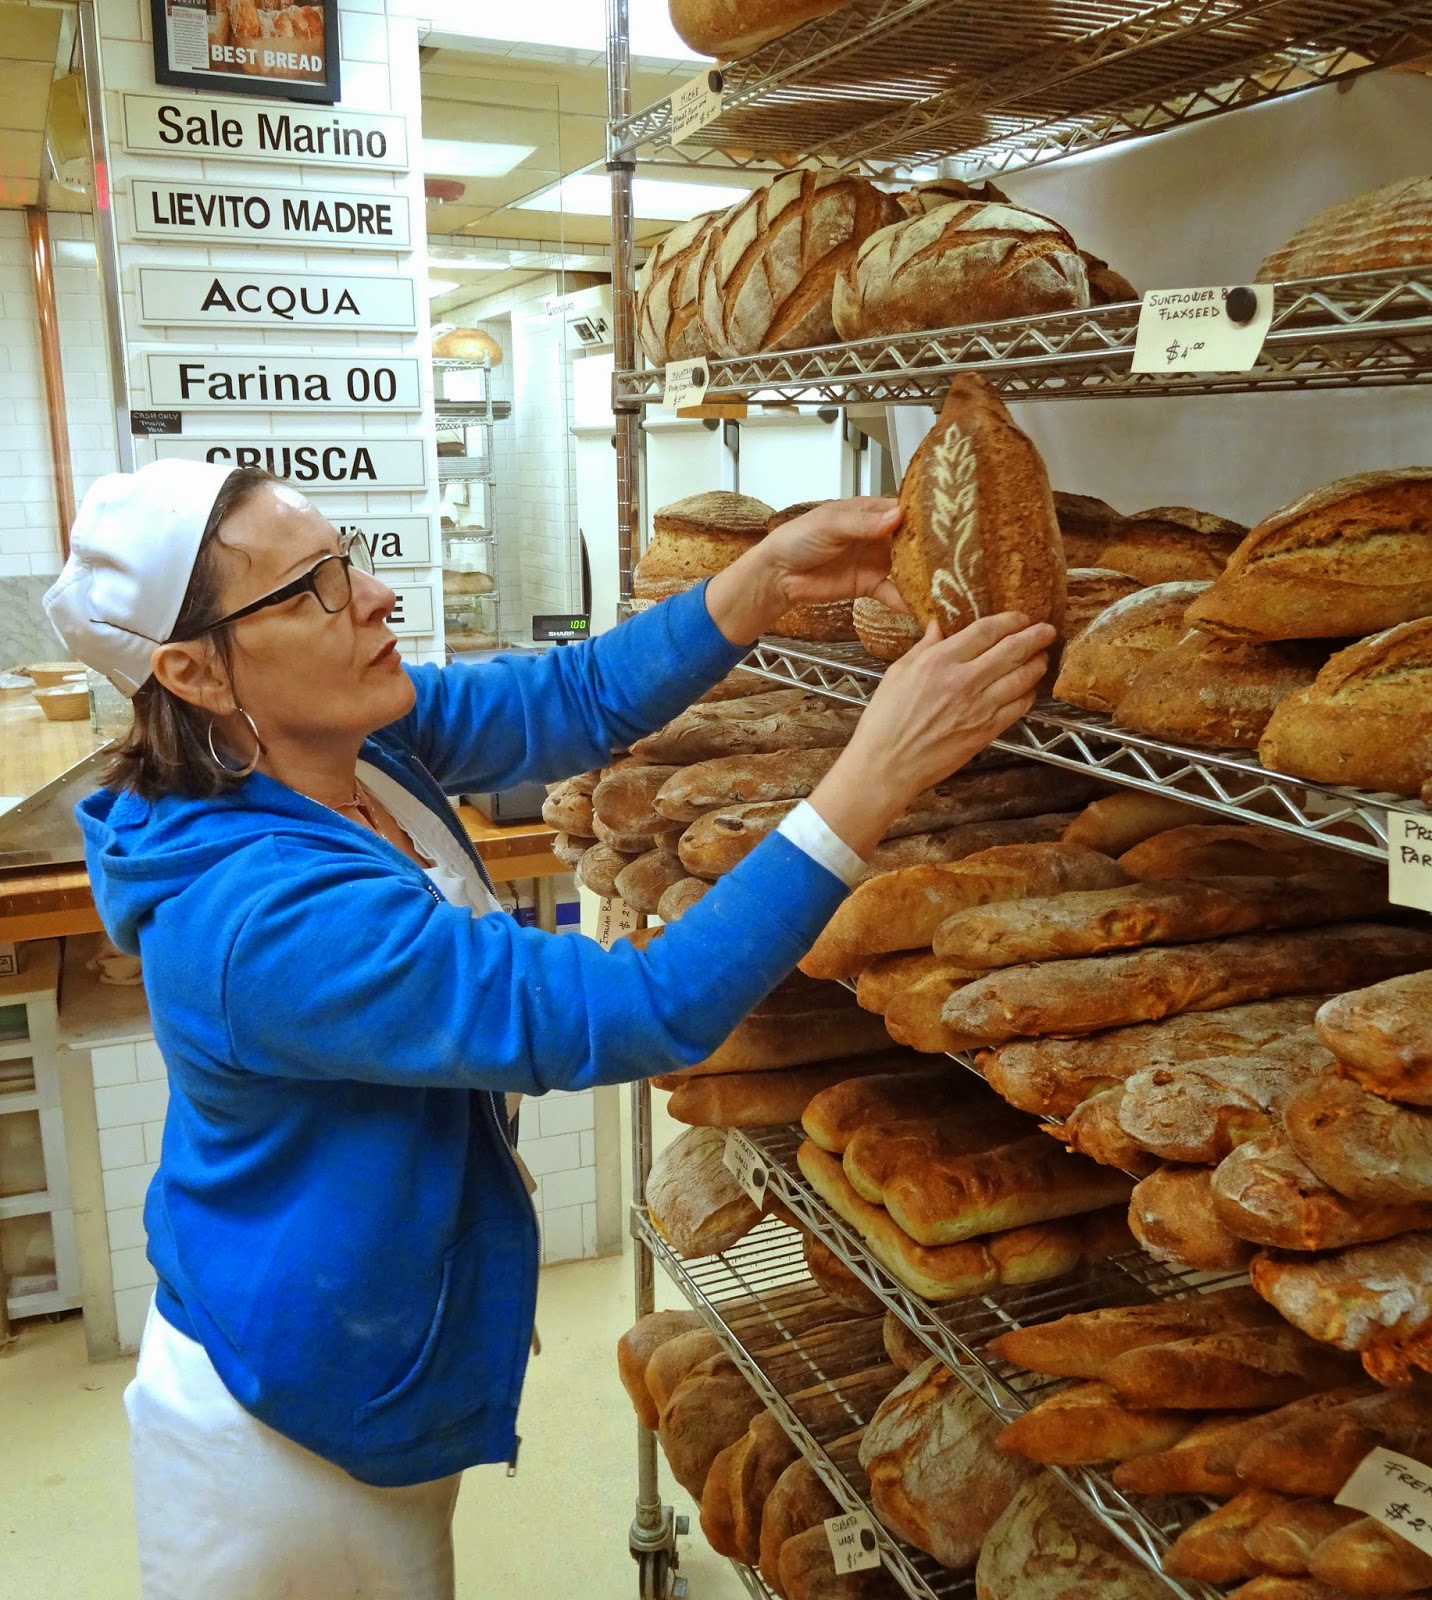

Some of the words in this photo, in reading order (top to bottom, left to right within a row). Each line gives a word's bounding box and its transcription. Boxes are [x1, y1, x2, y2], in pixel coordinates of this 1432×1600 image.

[211, 44, 257, 65] BEST
[264, 50, 323, 72] BREAD
[157, 105, 243, 148] Sale
[257, 112, 387, 159] Marino
[151, 191, 271, 230] LIEVITO
[282, 198, 393, 236] MADRE
[200, 278, 361, 320] ACQUA
[1149, 290, 1215, 307] SUNFLOWER
[1158, 306, 1220, 320] FLAXSEED
[178, 363, 331, 401] Farina
[346, 367, 397, 403] 00
[133, 412, 157, 420] CASH
[158, 412, 179, 421] ONLY
